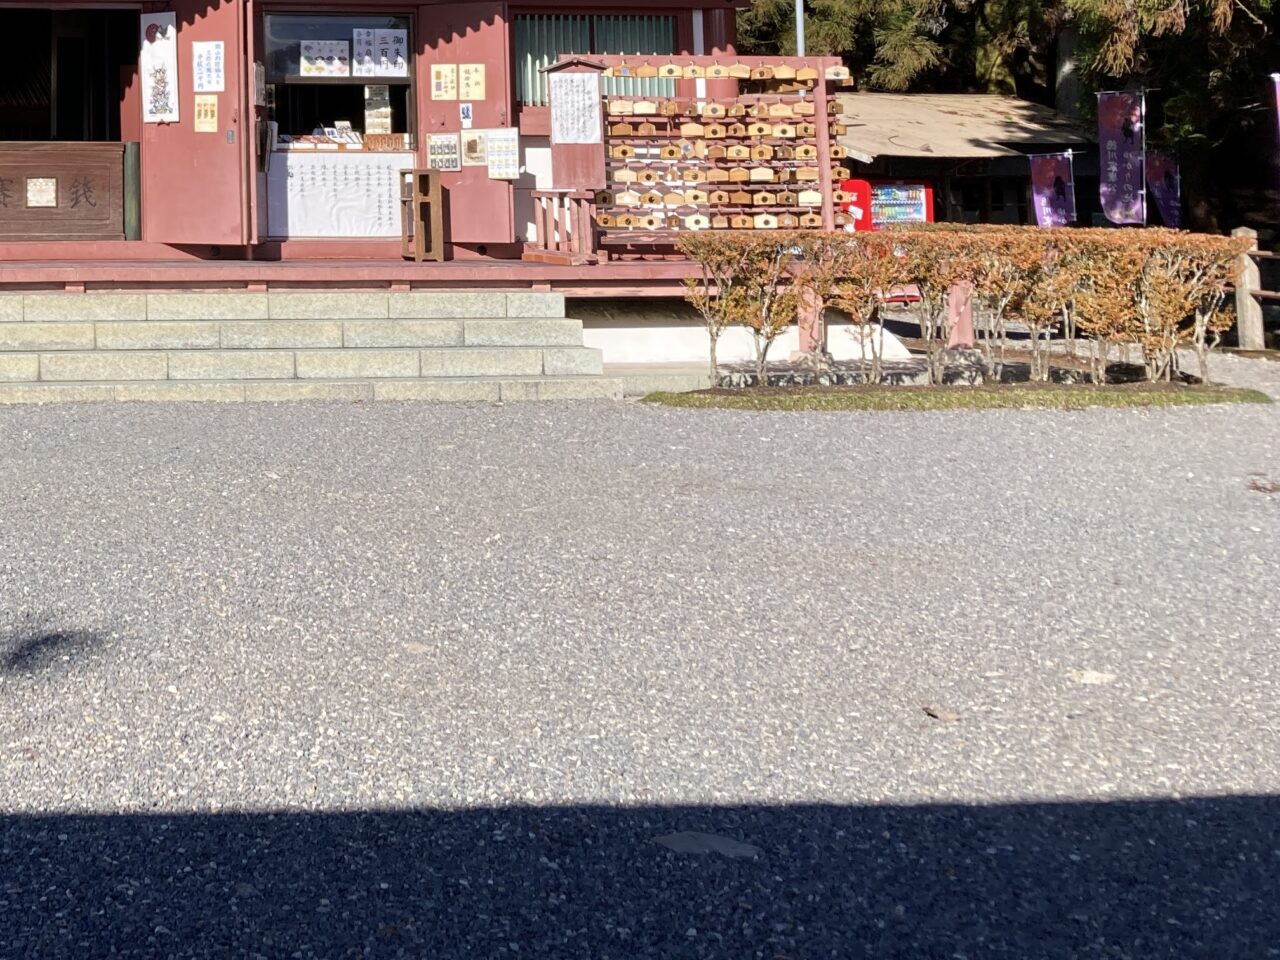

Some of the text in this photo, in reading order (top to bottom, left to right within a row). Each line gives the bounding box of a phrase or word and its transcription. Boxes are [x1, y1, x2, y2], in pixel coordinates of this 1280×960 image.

[378, 36, 390, 70] 三百円
[392, 35, 404, 70] 御朱印
